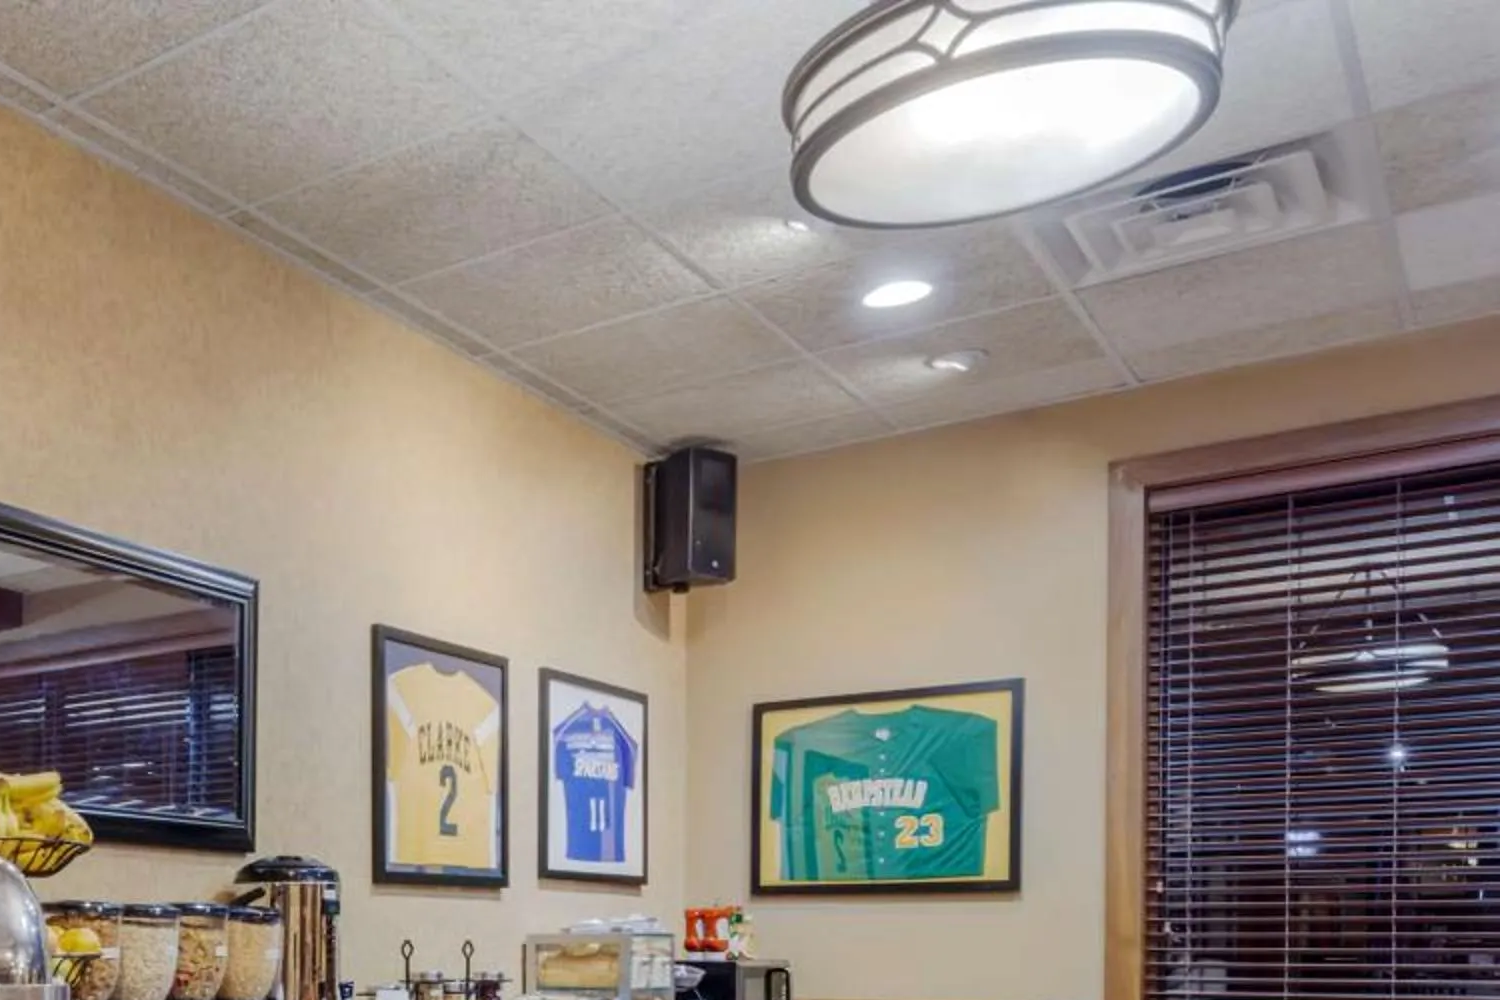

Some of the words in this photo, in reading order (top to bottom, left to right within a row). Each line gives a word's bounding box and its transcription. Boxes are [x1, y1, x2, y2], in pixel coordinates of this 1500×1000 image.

[418, 721, 471, 774] CLARKE
[439, 764, 458, 837] 2
[589, 797, 606, 833] 11
[894, 812, 945, 850] 23
